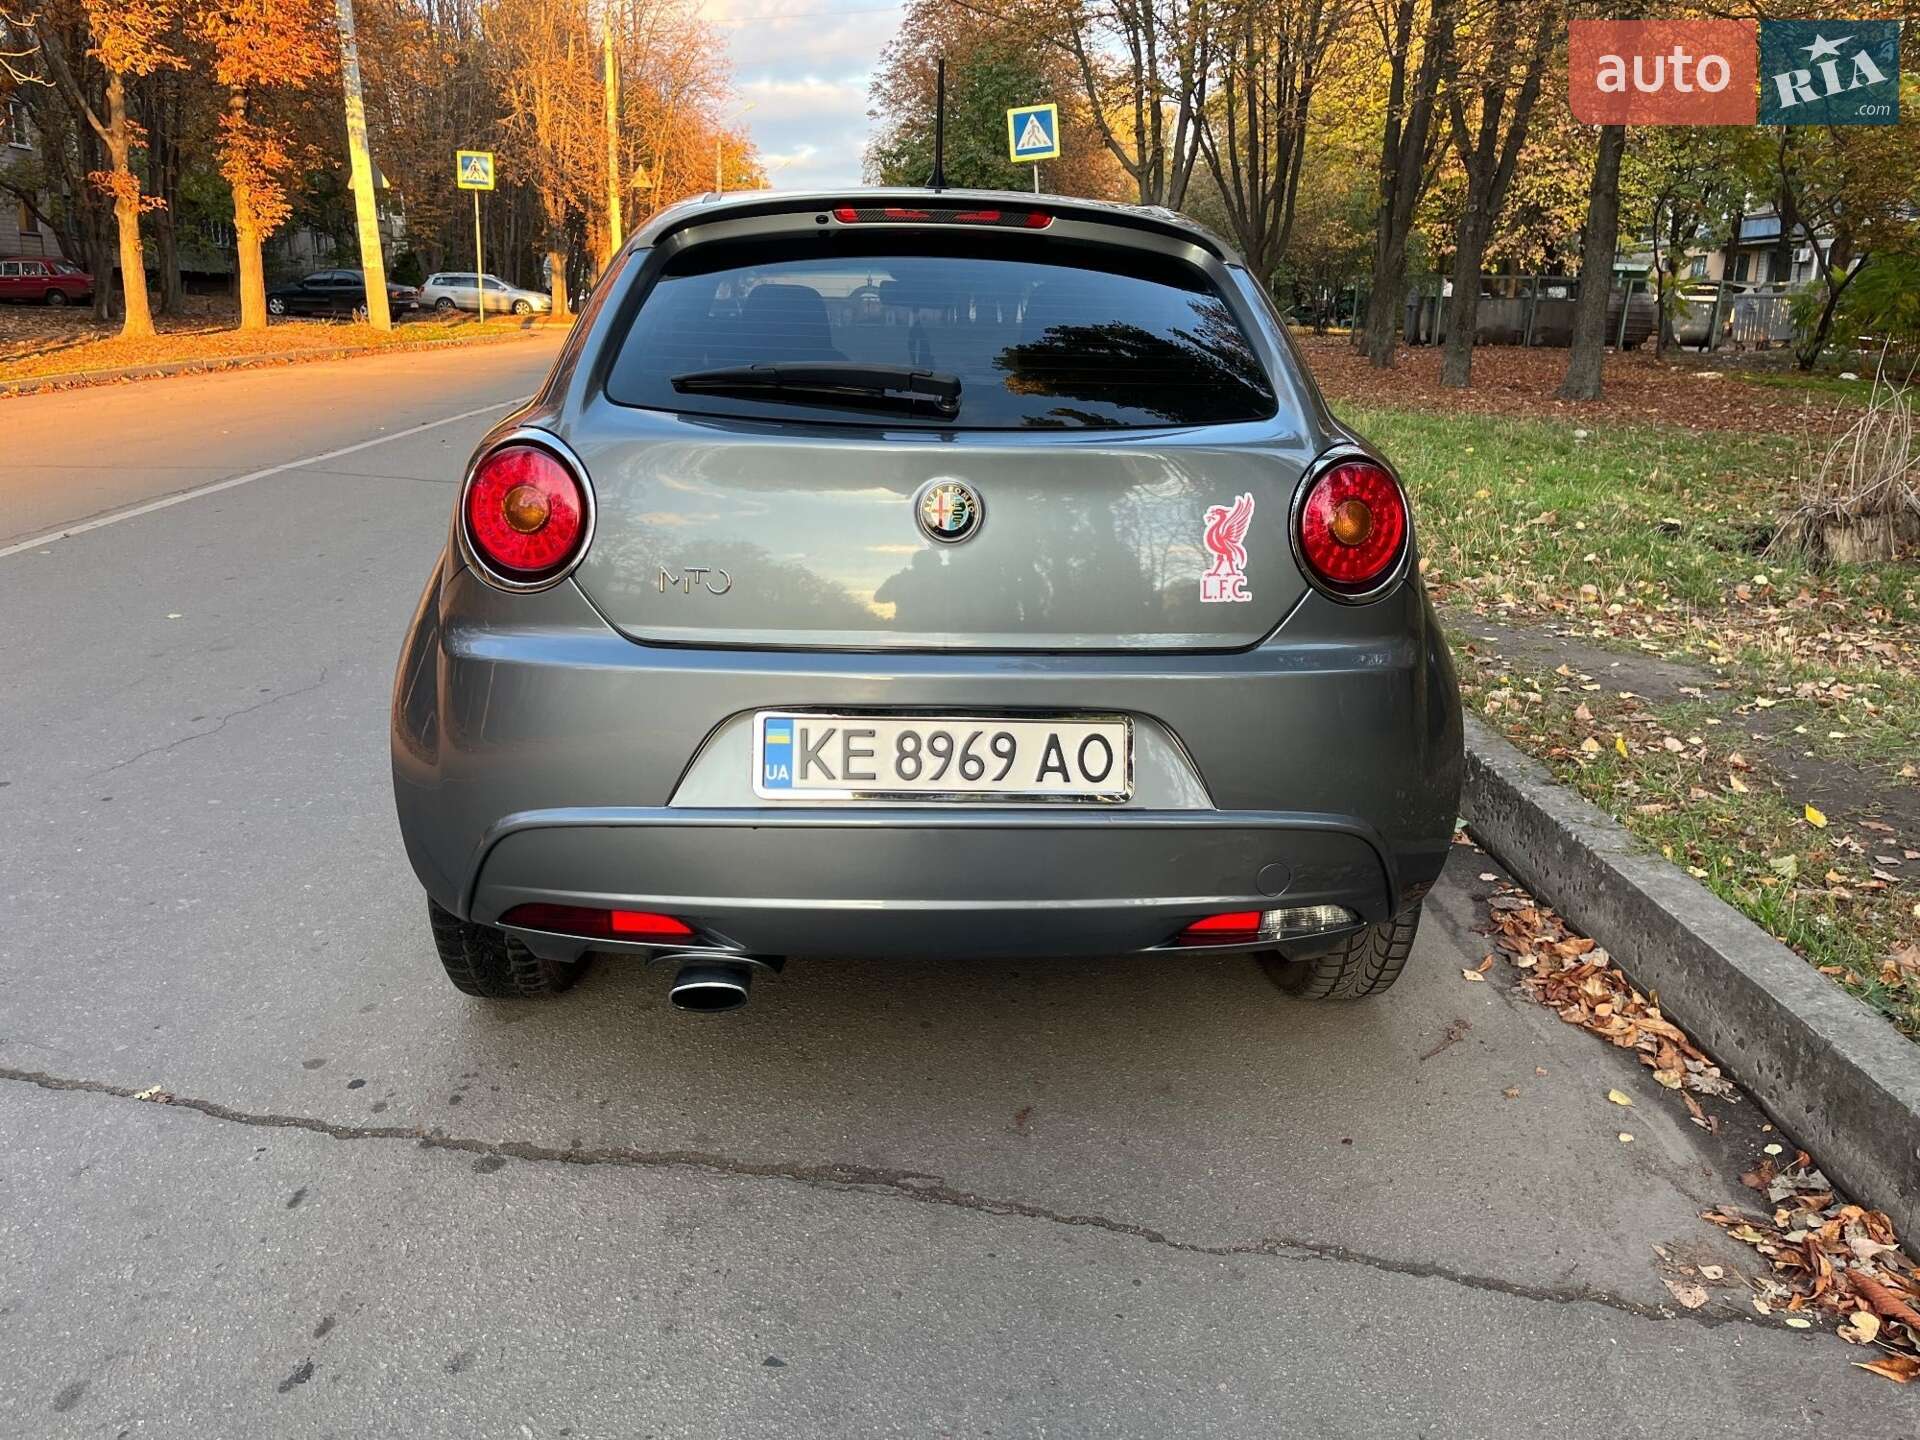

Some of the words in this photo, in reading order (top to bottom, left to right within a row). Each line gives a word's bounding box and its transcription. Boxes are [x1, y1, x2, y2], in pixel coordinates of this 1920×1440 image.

[1202, 578, 1251, 599] L.F.C.
[799, 727, 876, 781] KE
[895, 730, 1018, 782] 8969
[1035, 733, 1114, 783] AO
[765, 763, 790, 781] UA
